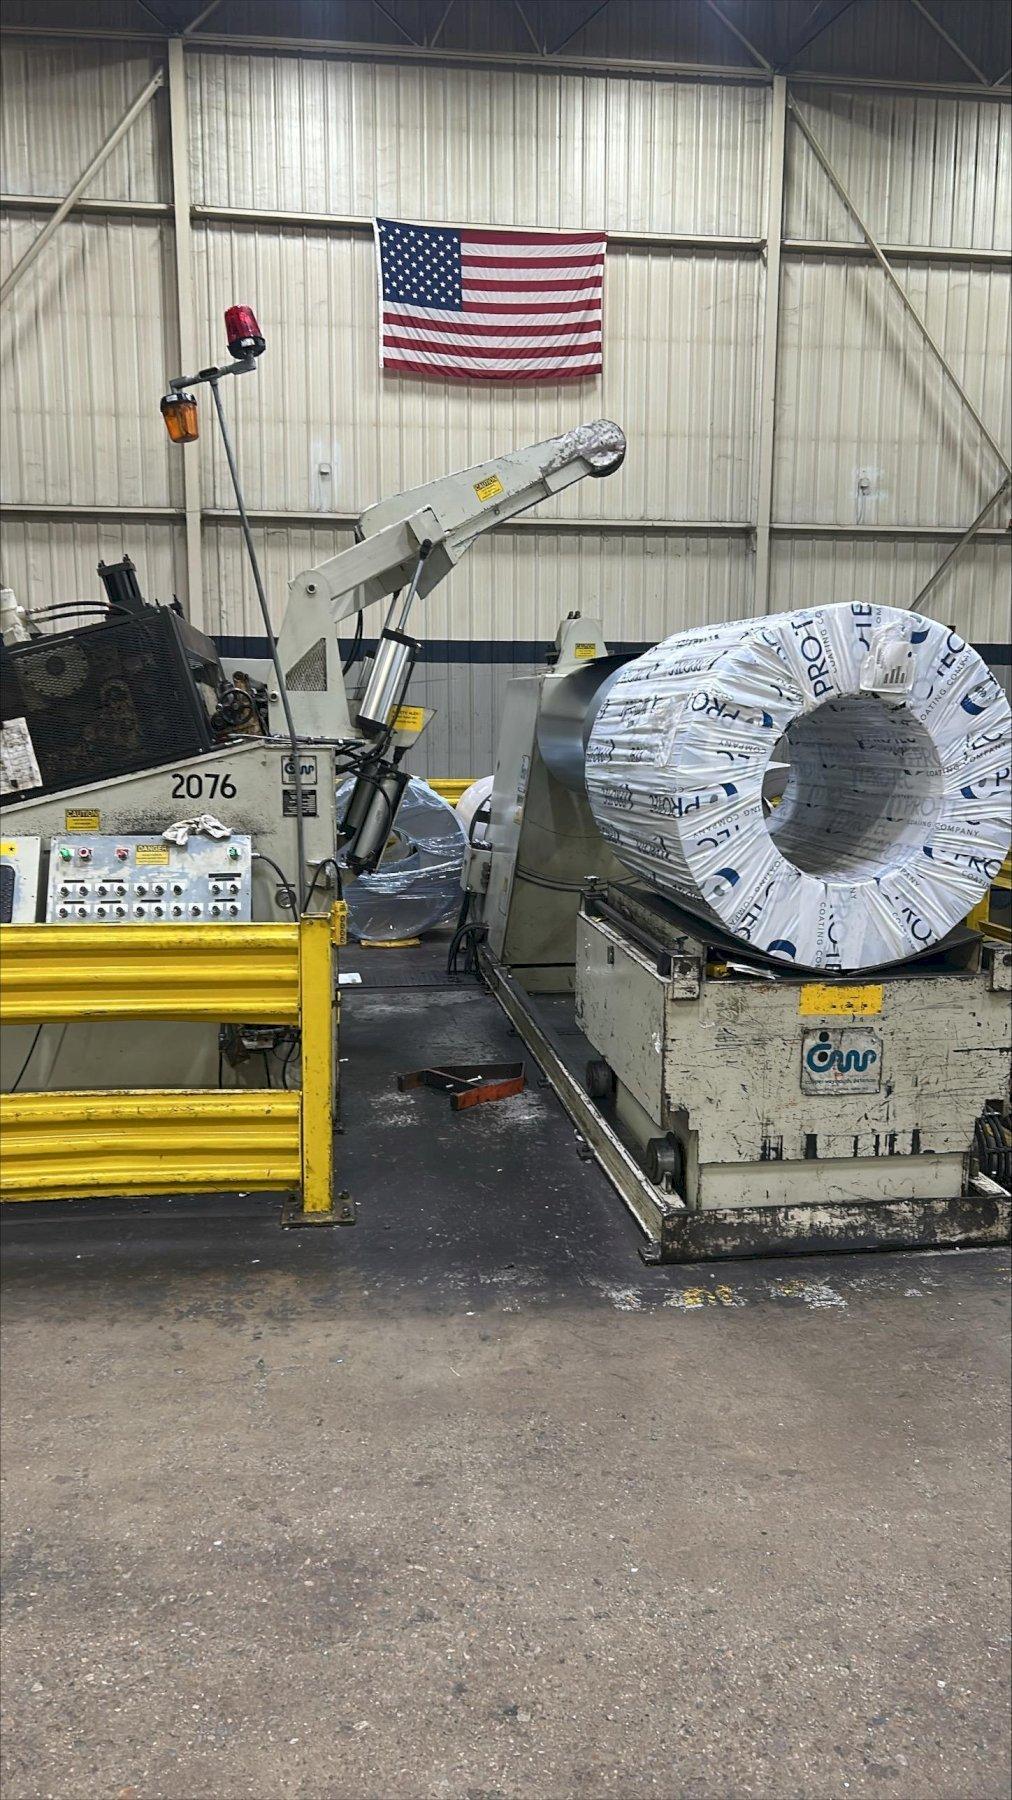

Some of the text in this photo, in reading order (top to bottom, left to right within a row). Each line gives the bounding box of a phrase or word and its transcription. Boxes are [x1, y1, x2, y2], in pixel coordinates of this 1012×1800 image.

[963, 740, 1007, 765] COMPANY
[171, 773, 237, 799] 2076
[693, 814, 740, 838] COMPANY
[935, 821, 980, 837] COMPANY
[816, 902, 827, 945] COATING
